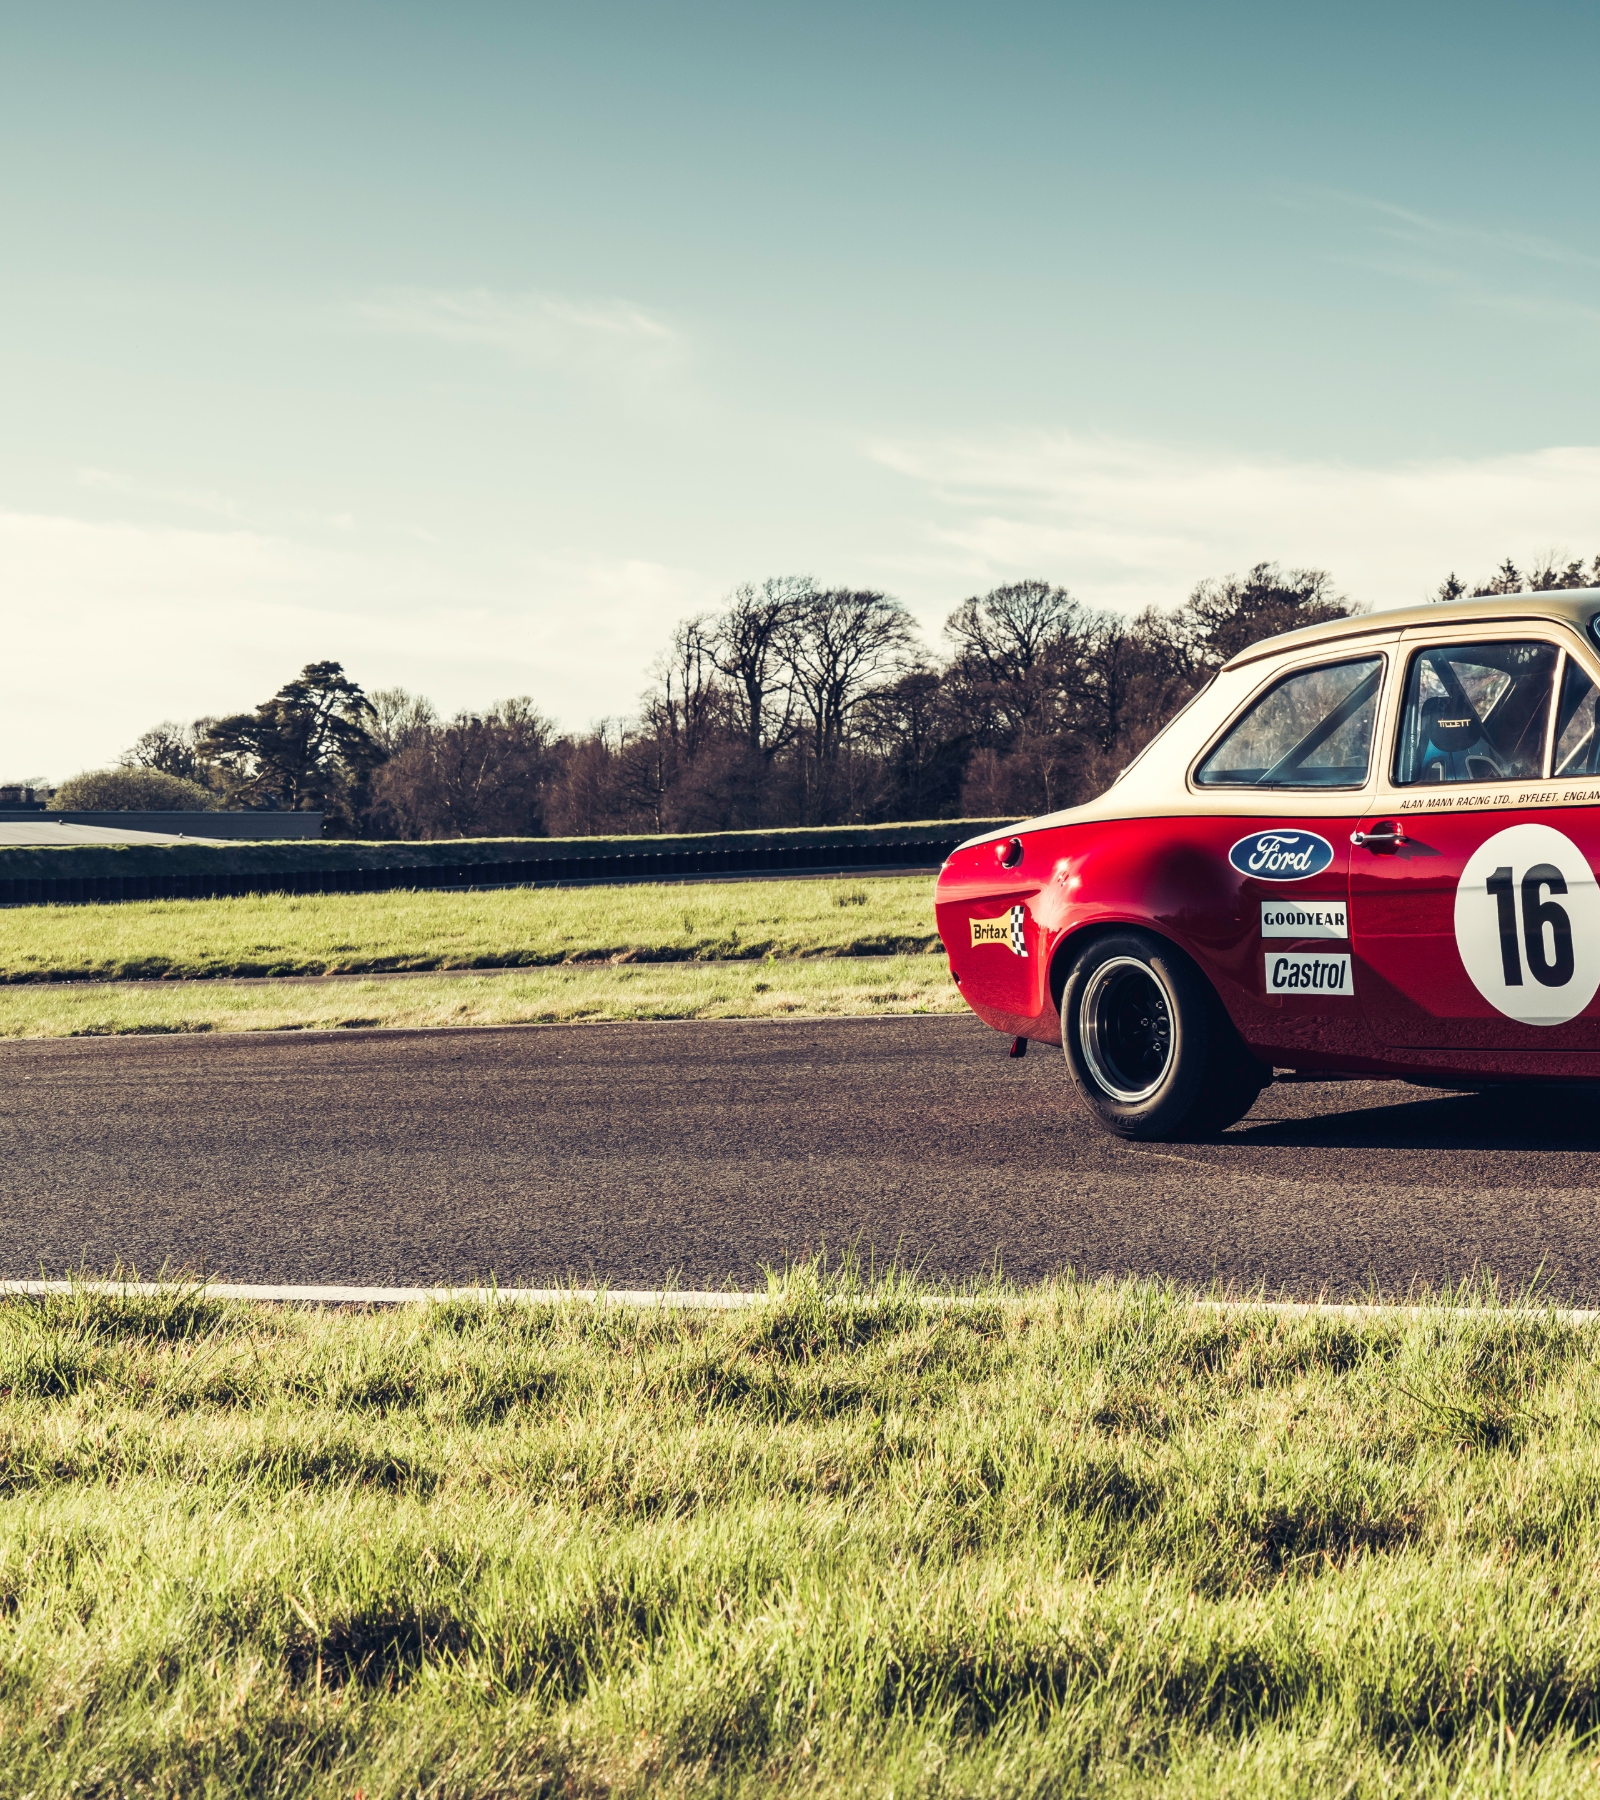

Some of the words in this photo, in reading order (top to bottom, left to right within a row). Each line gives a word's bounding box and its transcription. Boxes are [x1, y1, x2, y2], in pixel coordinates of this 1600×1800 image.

[1438, 718, 1471, 728] TILLETT
[1399, 800, 1424, 810] ALAN
[1426, 798, 1454, 808] MANN
[1456, 796, 1490, 806] RACING
[1518, 792, 1559, 803] BYFLEET,
[1248, 835, 1314, 871] Ford
[1264, 912, 1345, 926] GOODYEAR
[1486, 863, 1575, 988] 16
[973, 923, 1008, 940] Britax
[1272, 957, 1346, 989] Castrol
